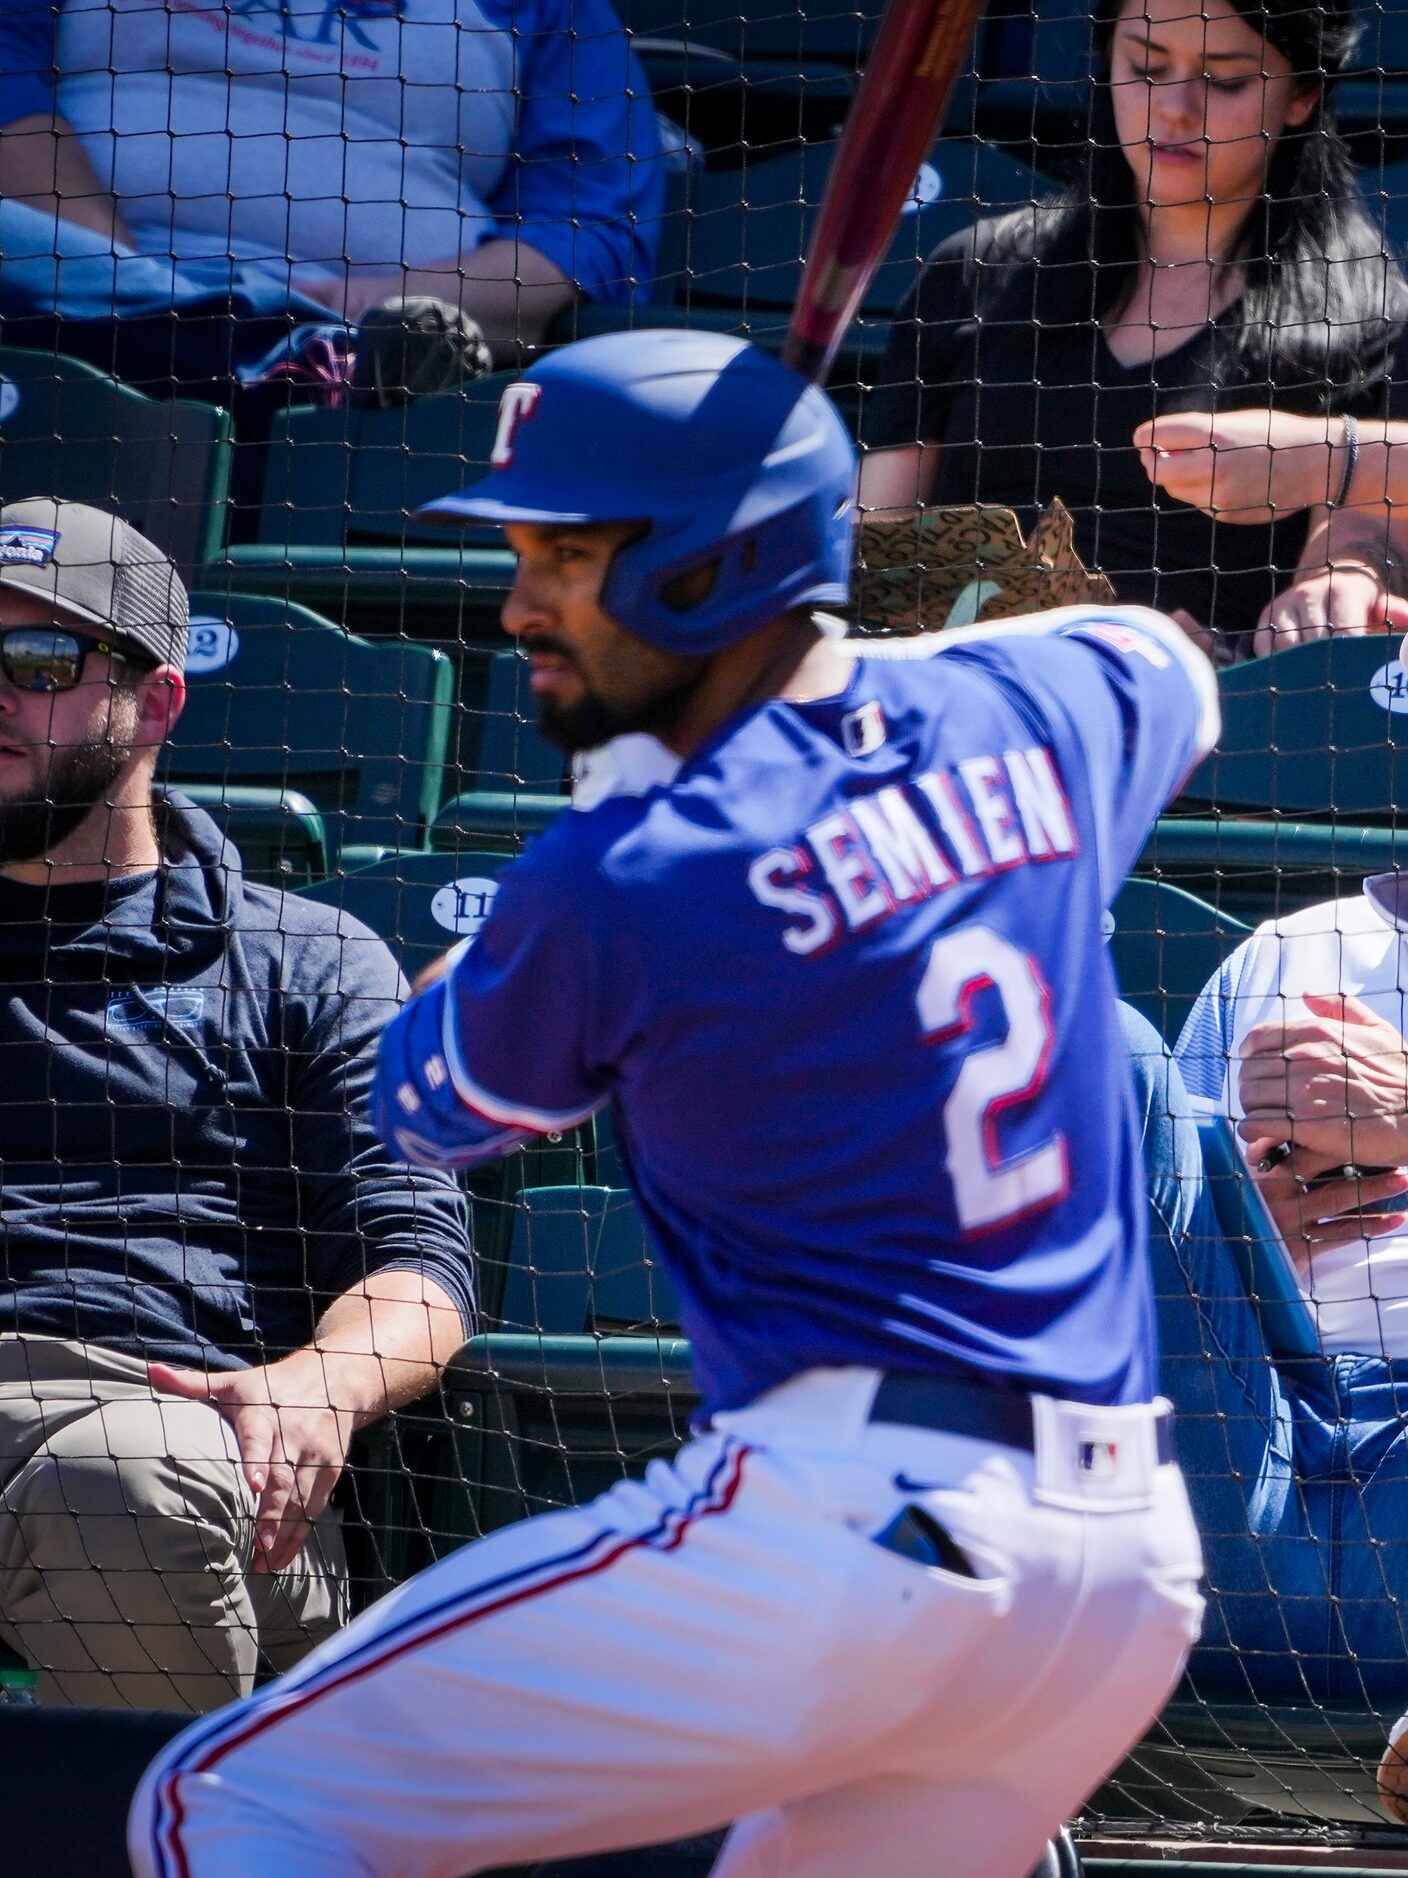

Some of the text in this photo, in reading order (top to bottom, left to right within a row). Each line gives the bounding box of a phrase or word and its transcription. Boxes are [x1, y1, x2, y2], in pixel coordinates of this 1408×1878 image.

[490, 382, 542, 468] T
[190, 628, 218, 657] 2
[748, 745, 1081, 958] SEMIEN
[453, 891, 490, 918] 11
[914, 921, 1072, 1242] 2
